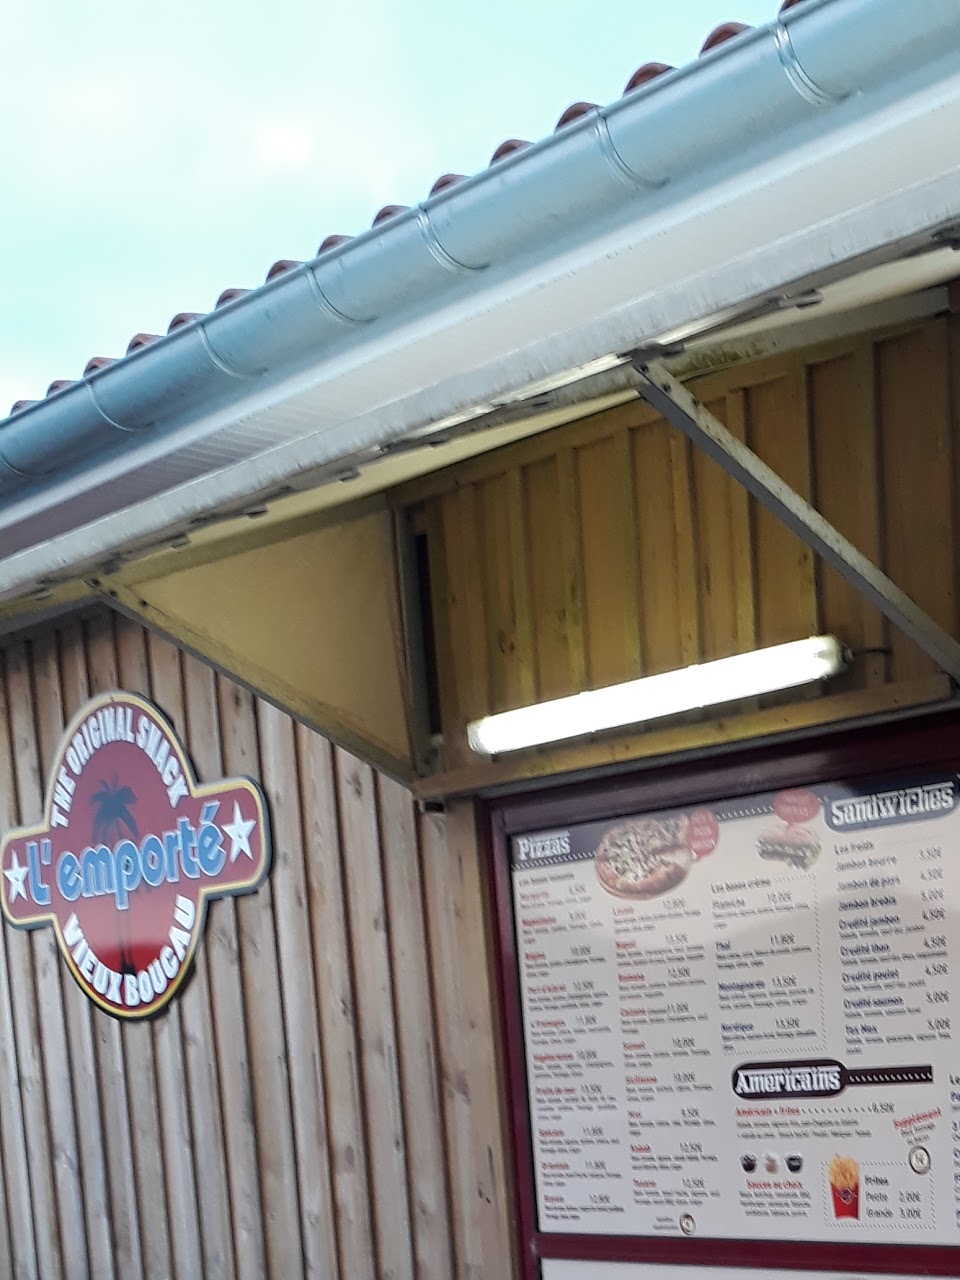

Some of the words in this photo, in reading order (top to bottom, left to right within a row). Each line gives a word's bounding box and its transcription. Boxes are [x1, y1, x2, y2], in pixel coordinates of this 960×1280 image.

[51, 769, 77, 828] THE
[67, 706, 135, 768] ORIGINAL
[137, 716, 189, 808] SNACK
[831, 781, 955, 826] Sandwiches
[517, 831, 571, 861] Pizzas
[63, 912, 122, 1005] VIEUX
[735, 1066, 841, 1094] Americains
